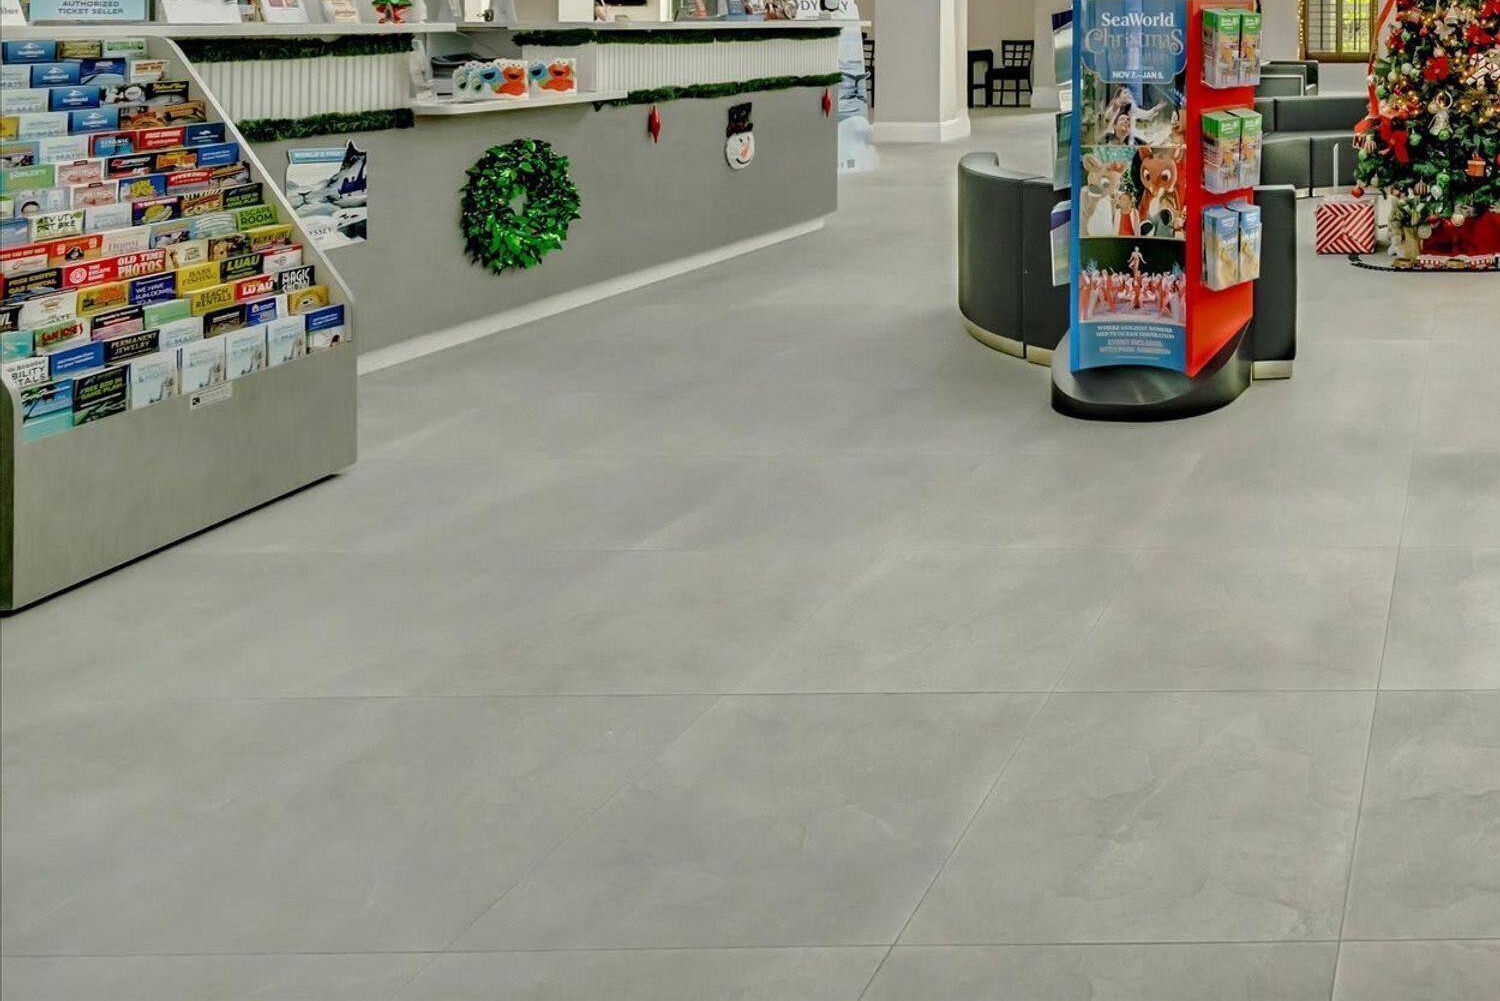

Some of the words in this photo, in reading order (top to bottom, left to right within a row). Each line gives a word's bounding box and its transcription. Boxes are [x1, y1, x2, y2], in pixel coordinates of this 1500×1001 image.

[58, 7, 89, 15] TICKET
[92, 7, 124, 15] SELLER
[62, 0, 121, 8] AUTHORIZED
[1101, 12, 1175, 27] SeaWorld
[240, 205, 272, 217] ESCAPE
[241, 212, 273, 226] ROOM
[117, 253, 137, 266] OLD
[141, 250, 165, 259] TIME
[228, 255, 261, 271] LUAU
[117, 259, 163, 279] PHOTOS
[136, 286, 149, 295] WE
[200, 287, 228, 300] BEACH
[242, 281, 274, 296] LUAU
[195, 294, 232, 308] RENTALS
[41, 330, 59, 343] SAN
[111, 332, 158, 349] PERMANENT
[114, 340, 151, 355] JEWELRY
